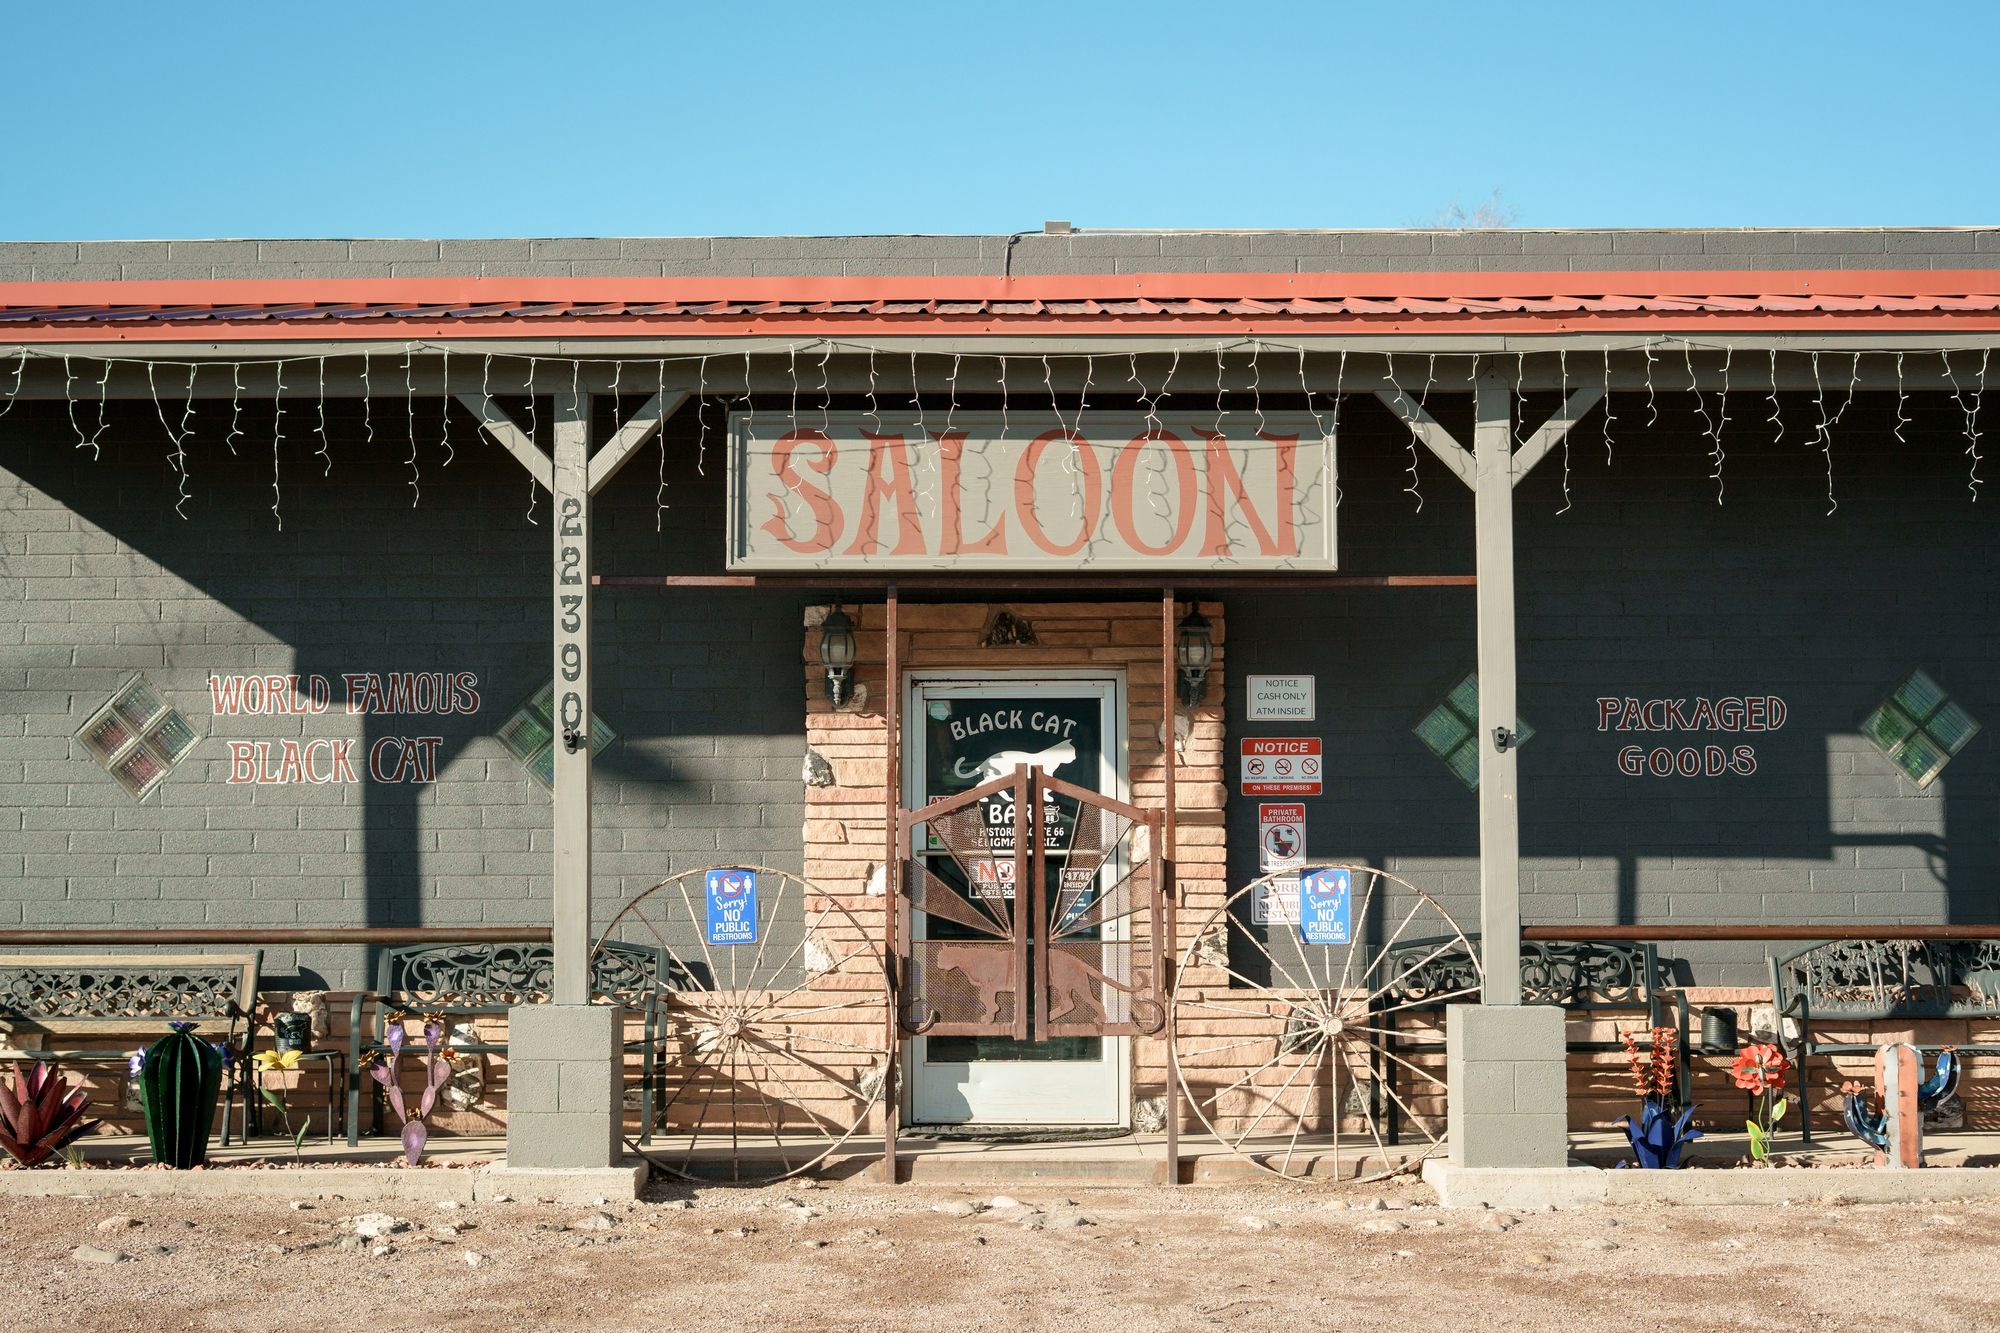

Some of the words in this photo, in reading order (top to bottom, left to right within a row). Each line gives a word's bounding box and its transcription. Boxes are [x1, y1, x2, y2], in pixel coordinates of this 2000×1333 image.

[760, 426, 1301, 557] SALOON
[560, 498, 583, 731] 22390
[1265, 679, 1299, 688] NOTICE
[206, 674, 331, 716] WORLD
[342, 671, 481, 715] FAMOUS
[1257, 692, 1281, 701] CASH
[1282, 692, 1307, 701] ONLY
[1256, 707, 1276, 715] ATM
[1277, 707, 1306, 715] INSIDE
[1597, 695, 1788, 732] PACKAGED
[950, 709, 1023, 741] BLACK
[1031, 711, 1078, 738] CAT
[1254, 742, 1309, 753] NOTICE
[226, 738, 359, 784] BLACK
[370, 736, 444, 784] CAT
[1618, 745, 1758, 777] GOODS
[1054, 828, 1065, 837] 66
[715, 892, 748, 911] Sorry!
[1258, 901, 1273, 910] NO
[1309, 894, 1342, 911] Sorry!
[723, 910, 741, 922] NO
[1317, 909, 1335, 921] NO
[715, 921, 750, 933] PUBLIC
[1308, 922, 1344, 932] PUBLIC
[712, 932, 753, 941] RESTROOMS
[1305, 932, 1346, 940] RESTROOMS
